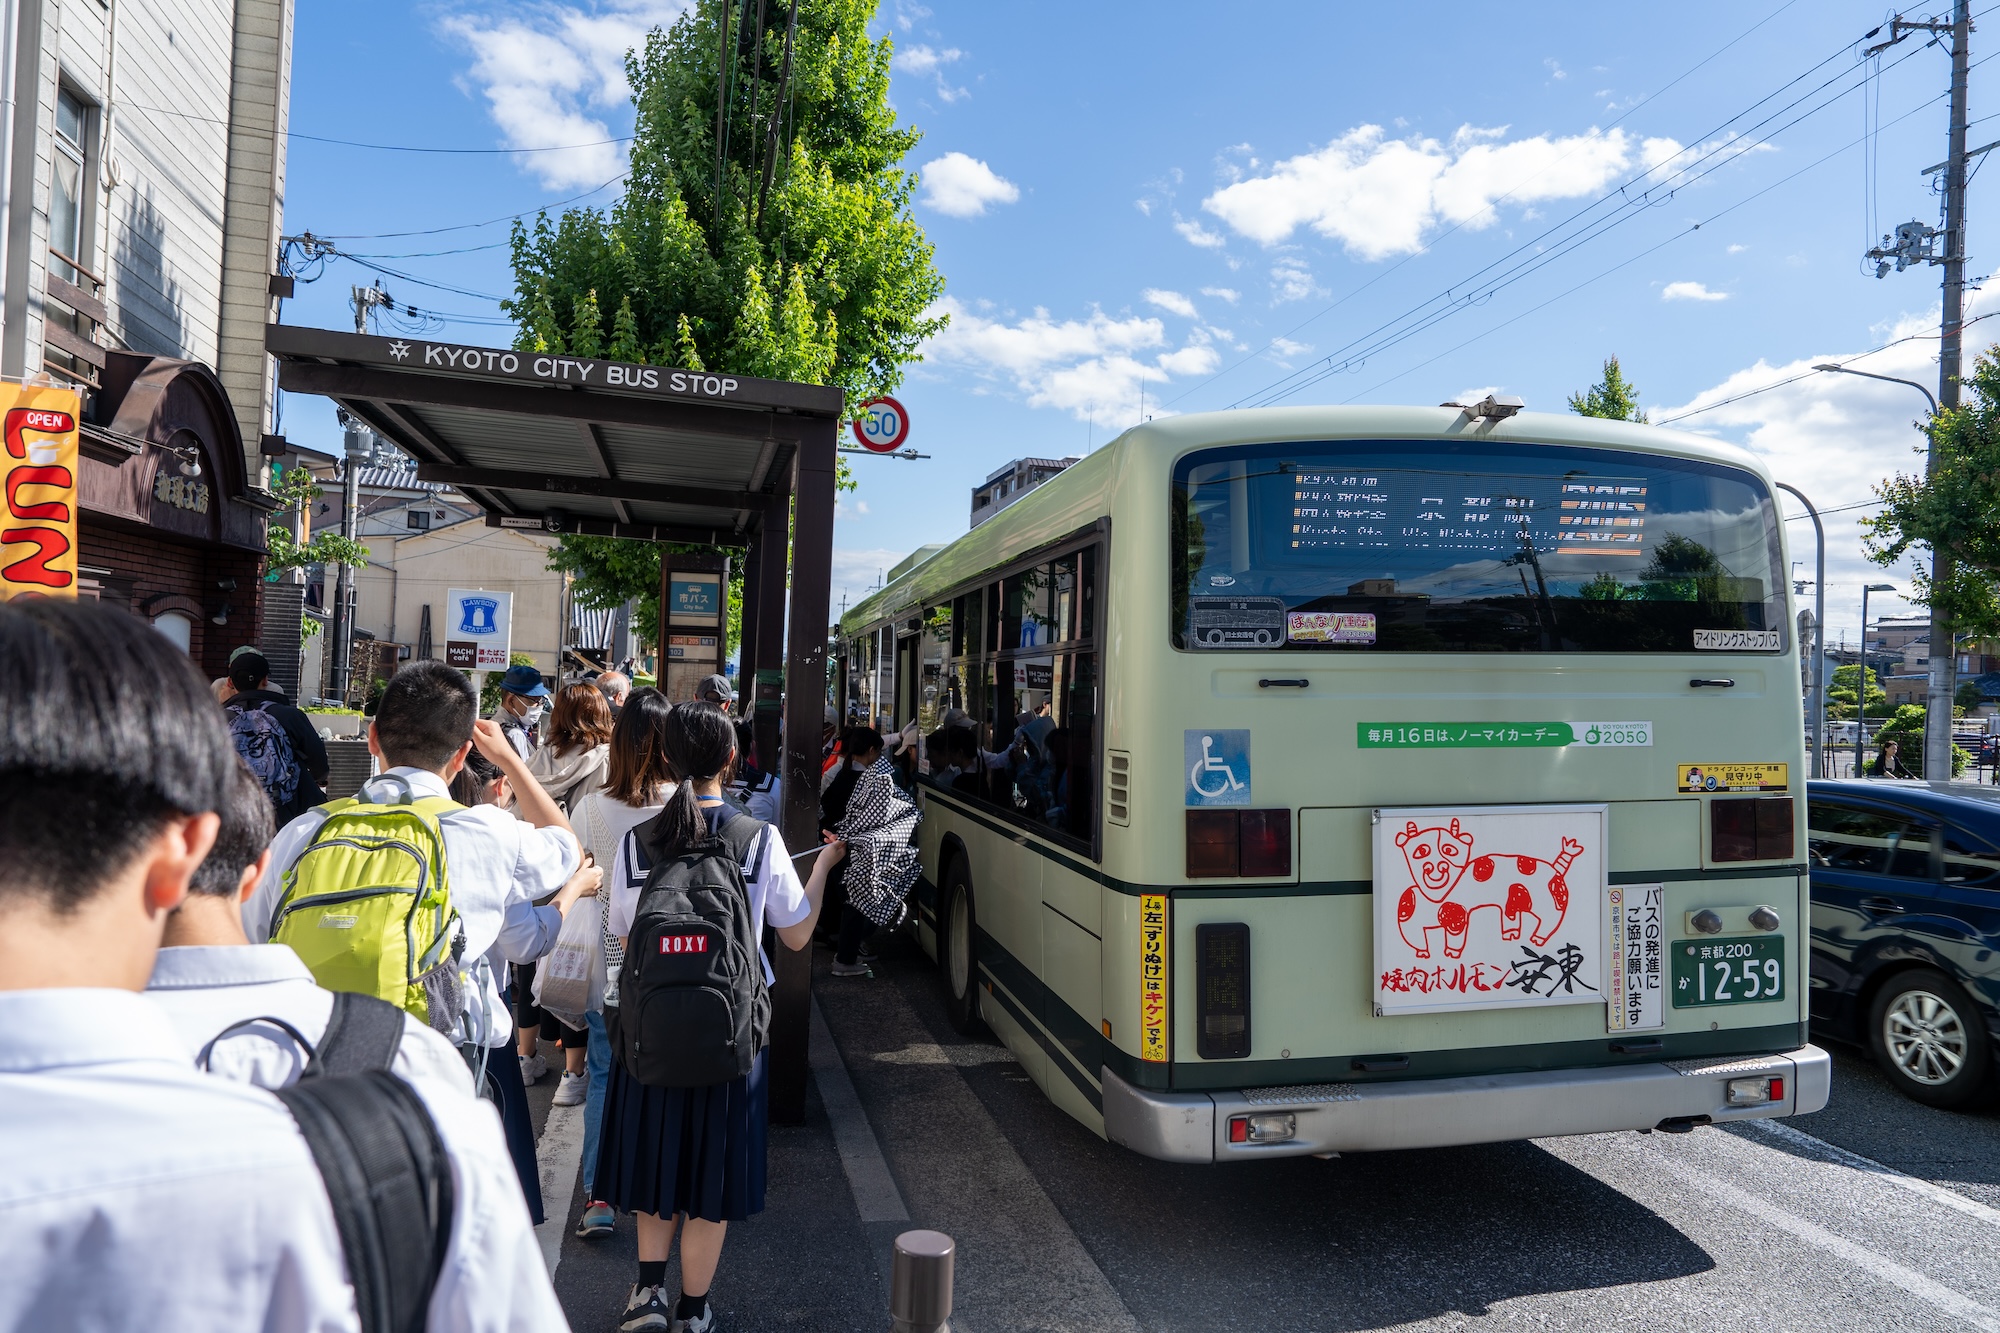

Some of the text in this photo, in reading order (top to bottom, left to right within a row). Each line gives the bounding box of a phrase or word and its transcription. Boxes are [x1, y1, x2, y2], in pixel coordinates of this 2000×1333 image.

[424, 345, 739, 396] KYOTO CITY BUS STOP
[26, 411, 63, 427] OPEN
[864, 410, 897, 437] 50
[1, 407, 75, 602] LUN
[463, 599, 496, 609] LAWSON
[679, 593, 709, 604] 市バス
[462, 624, 494, 633] STATION
[1290, 613, 1369, 632] はんなり運転
[672, 637, 684, 645] 204
[1695, 632, 1780, 647] アイドリングストップバス
[670, 648, 682, 656] 102
[478, 656, 506, 664] 銀行ATM
[1603, 730, 1648, 744] 2050
[1725, 772, 1763, 781] 見守り中
[662, 936, 705, 953] ROXY
[1644, 889, 1660, 990] バスの発進に
[1626, 906, 1642, 1026] ご協力願います
[1144, 910, 1164, 1049] 左「すりぬけ」はキケンです。
[1678, 976, 1691, 990] か
[1698, 958, 1780, 1002] 12-59
